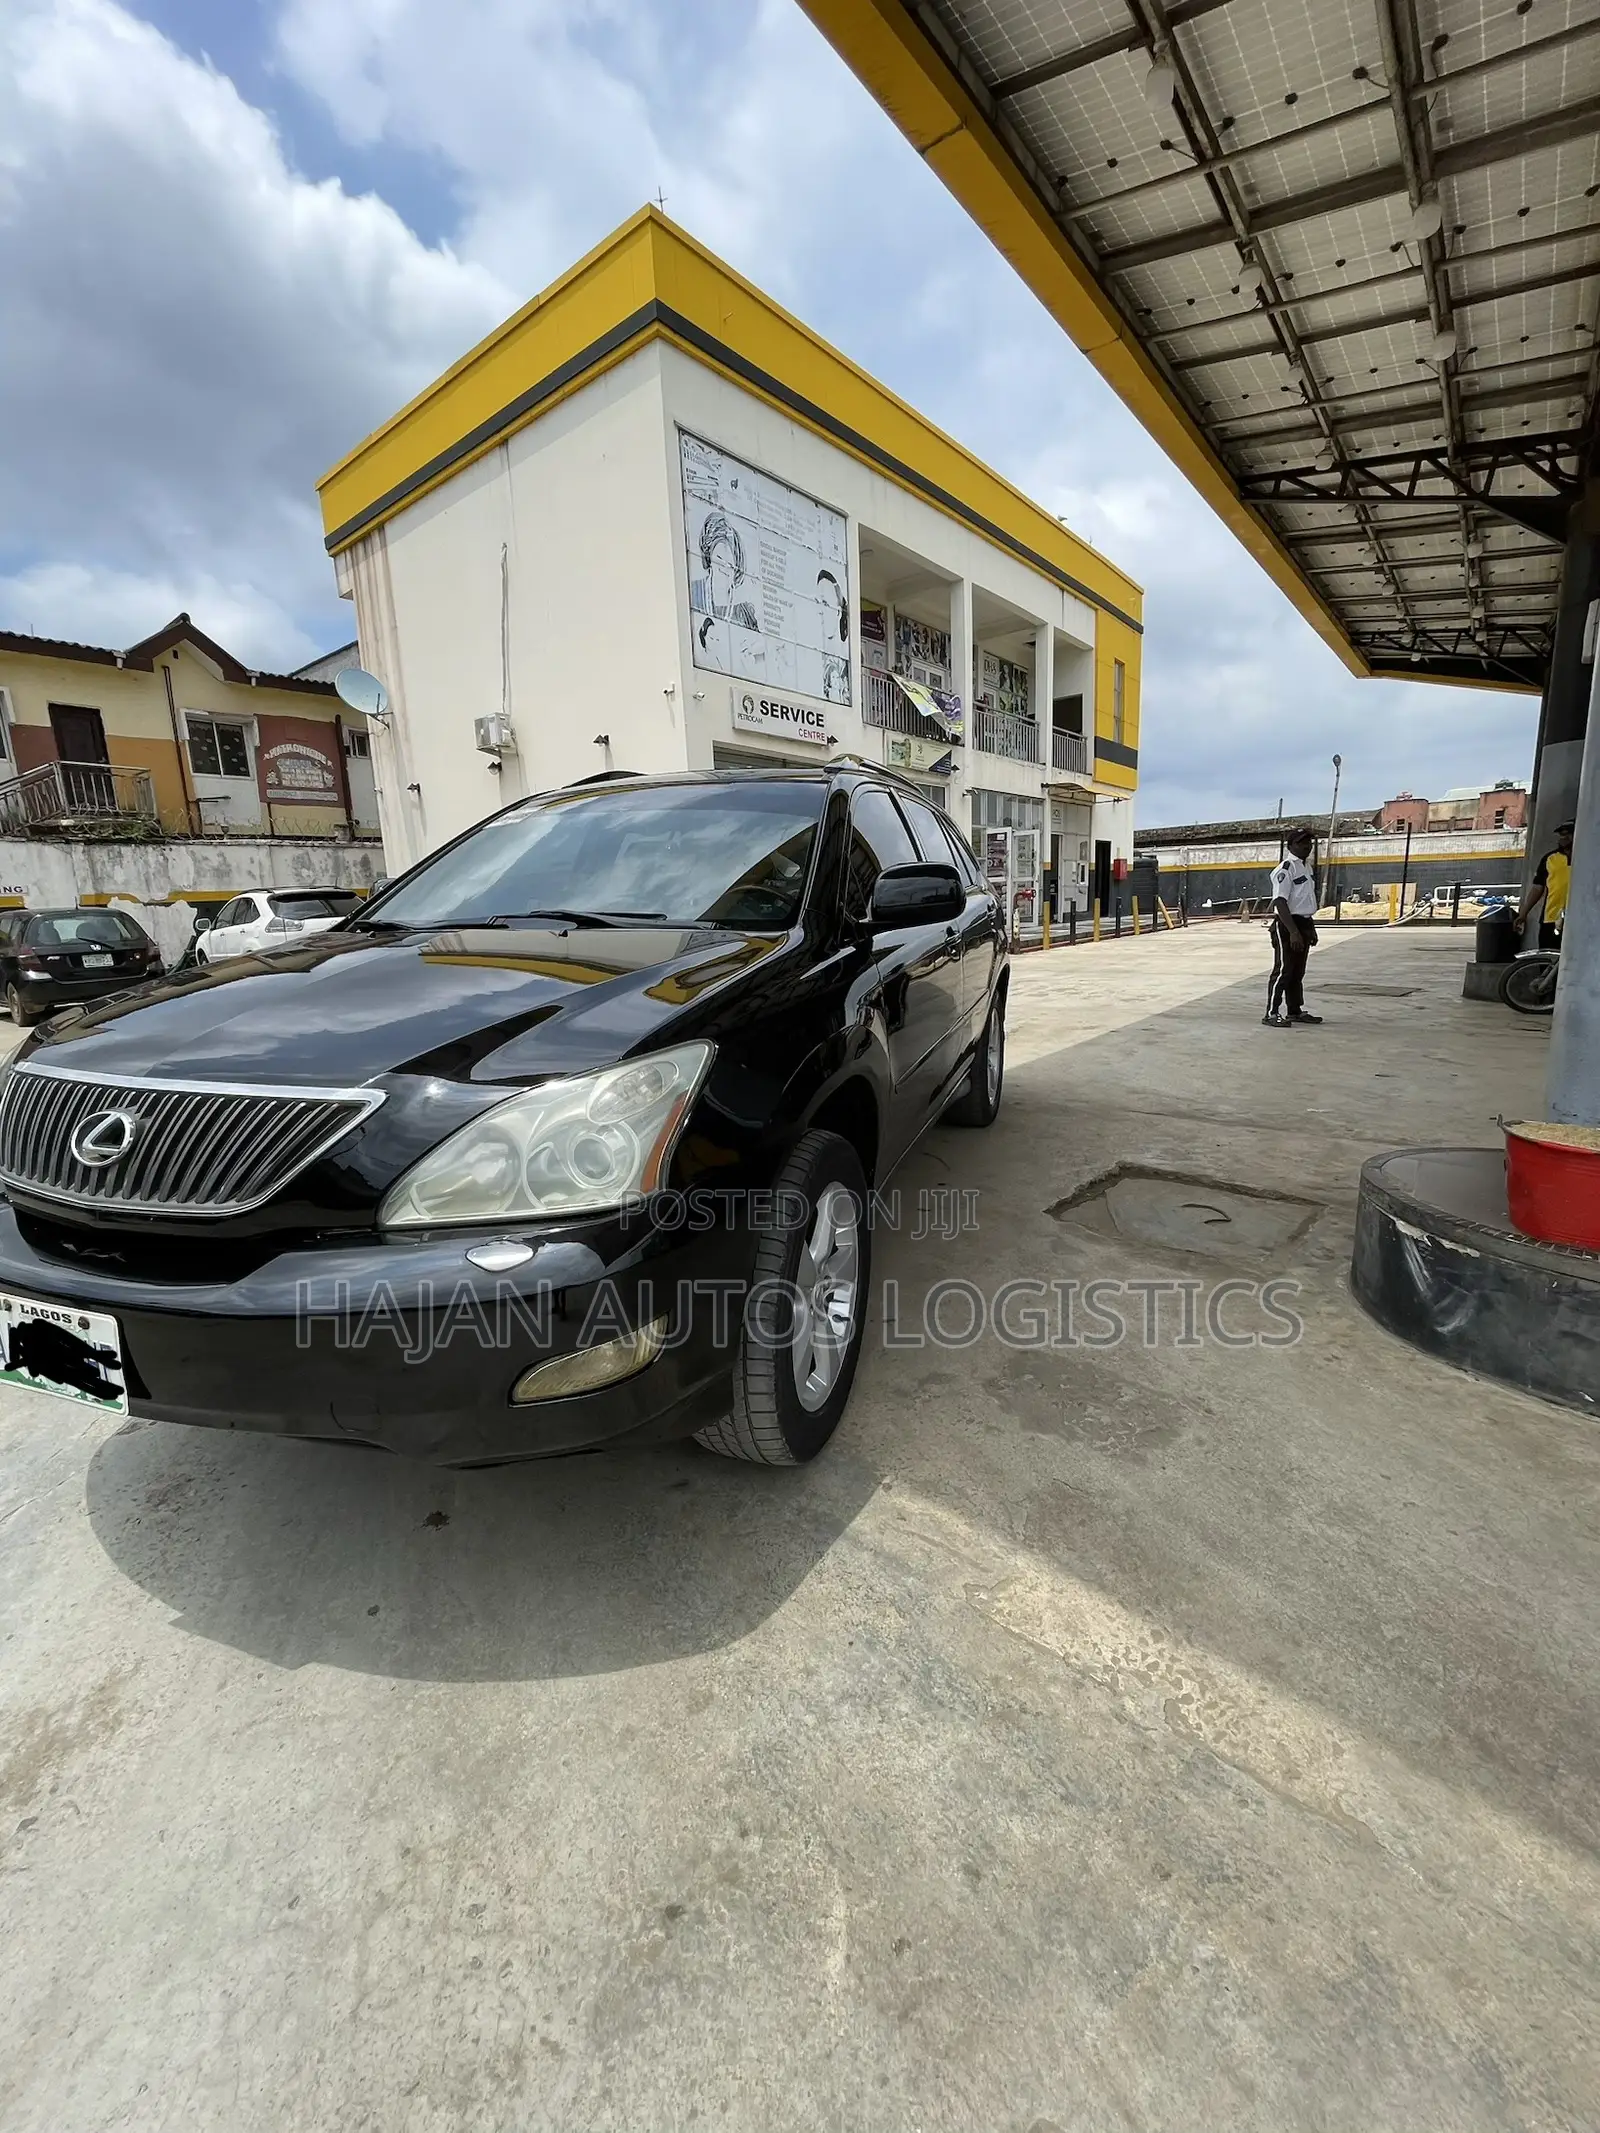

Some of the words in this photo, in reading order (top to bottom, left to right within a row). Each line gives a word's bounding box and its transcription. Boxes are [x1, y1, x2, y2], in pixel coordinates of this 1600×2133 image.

[760, 699, 825, 728] SERVICE
[798, 728, 826, 742] CENTRE
[20, 1304, 72, 1324] LAGOS
